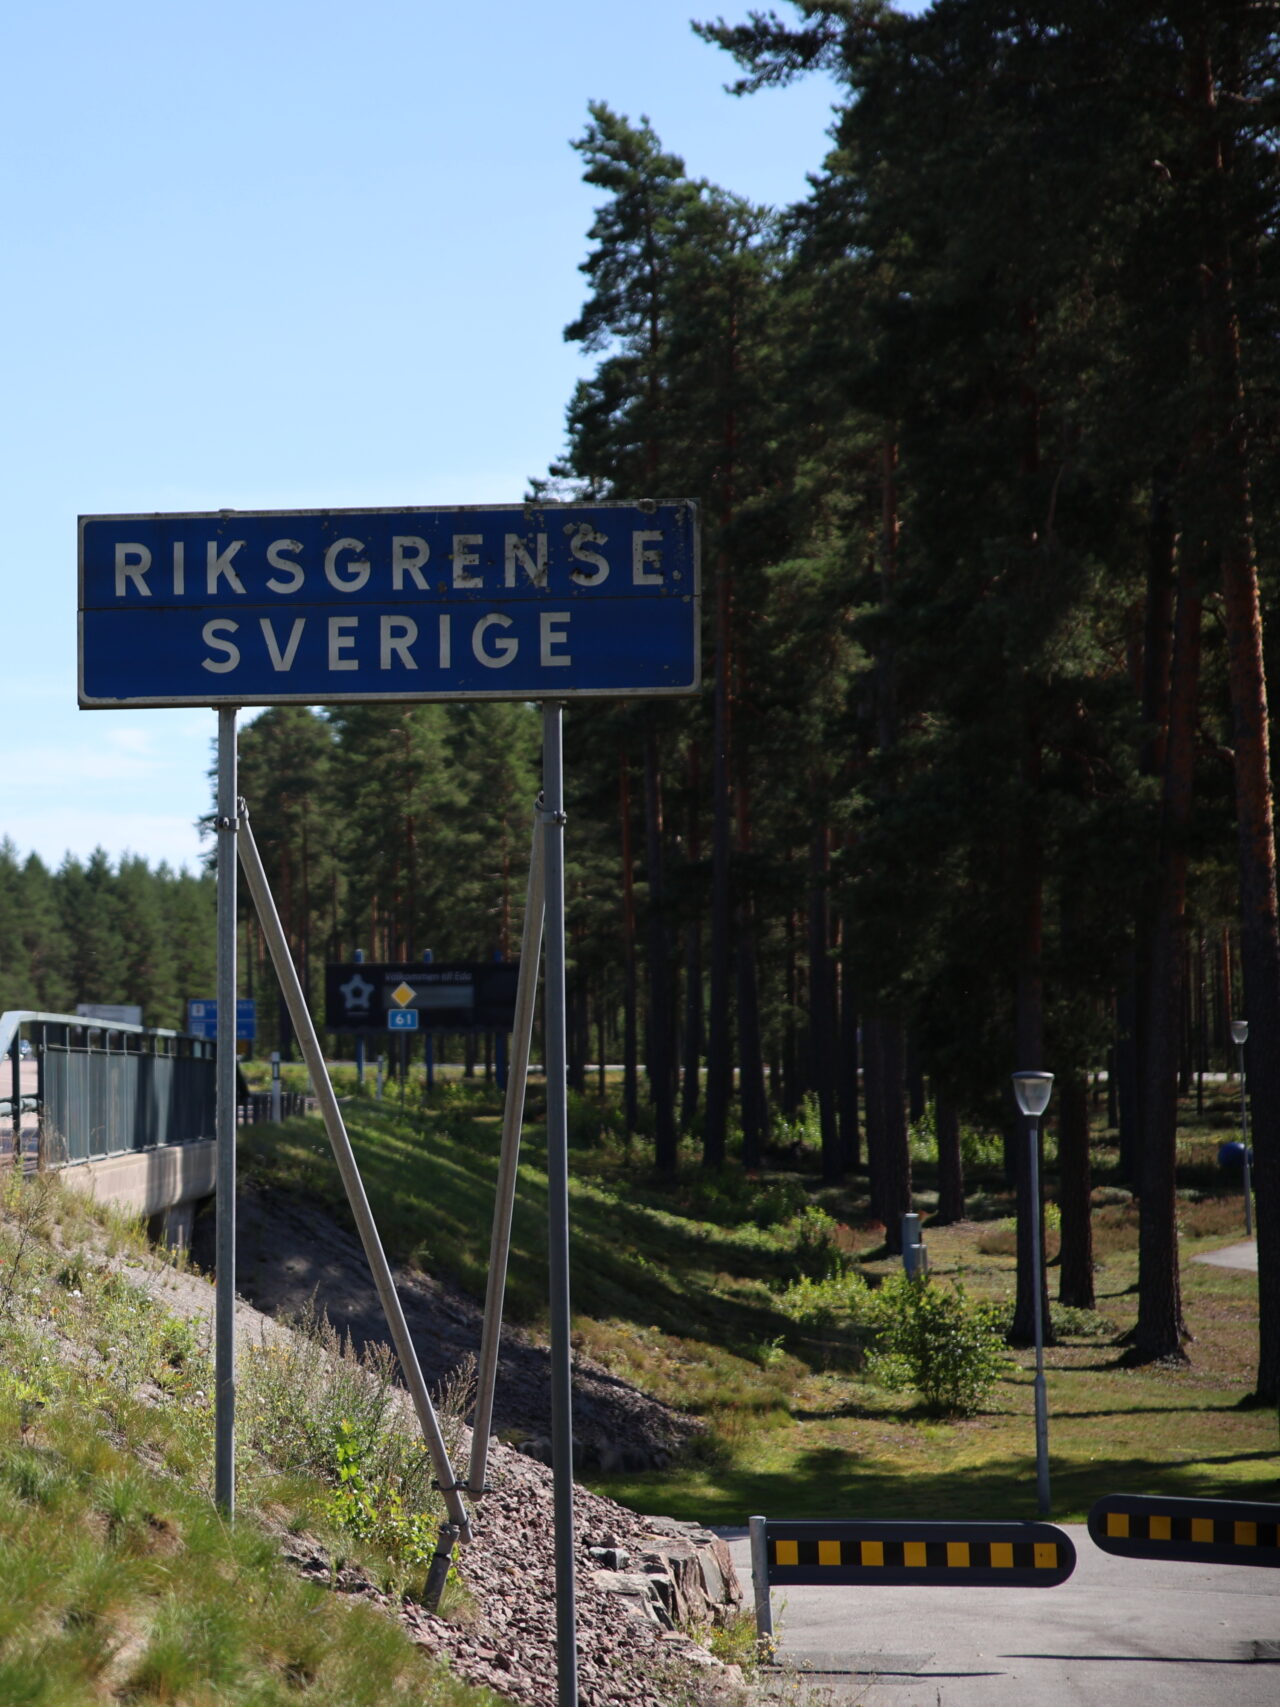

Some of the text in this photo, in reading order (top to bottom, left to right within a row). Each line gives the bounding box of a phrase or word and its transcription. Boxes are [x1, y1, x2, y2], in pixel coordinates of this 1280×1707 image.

[114, 529, 664, 597] RIKSGRENSE
[201, 611, 572, 674] SVERIGE
[395, 1014, 411, 1025] 61
